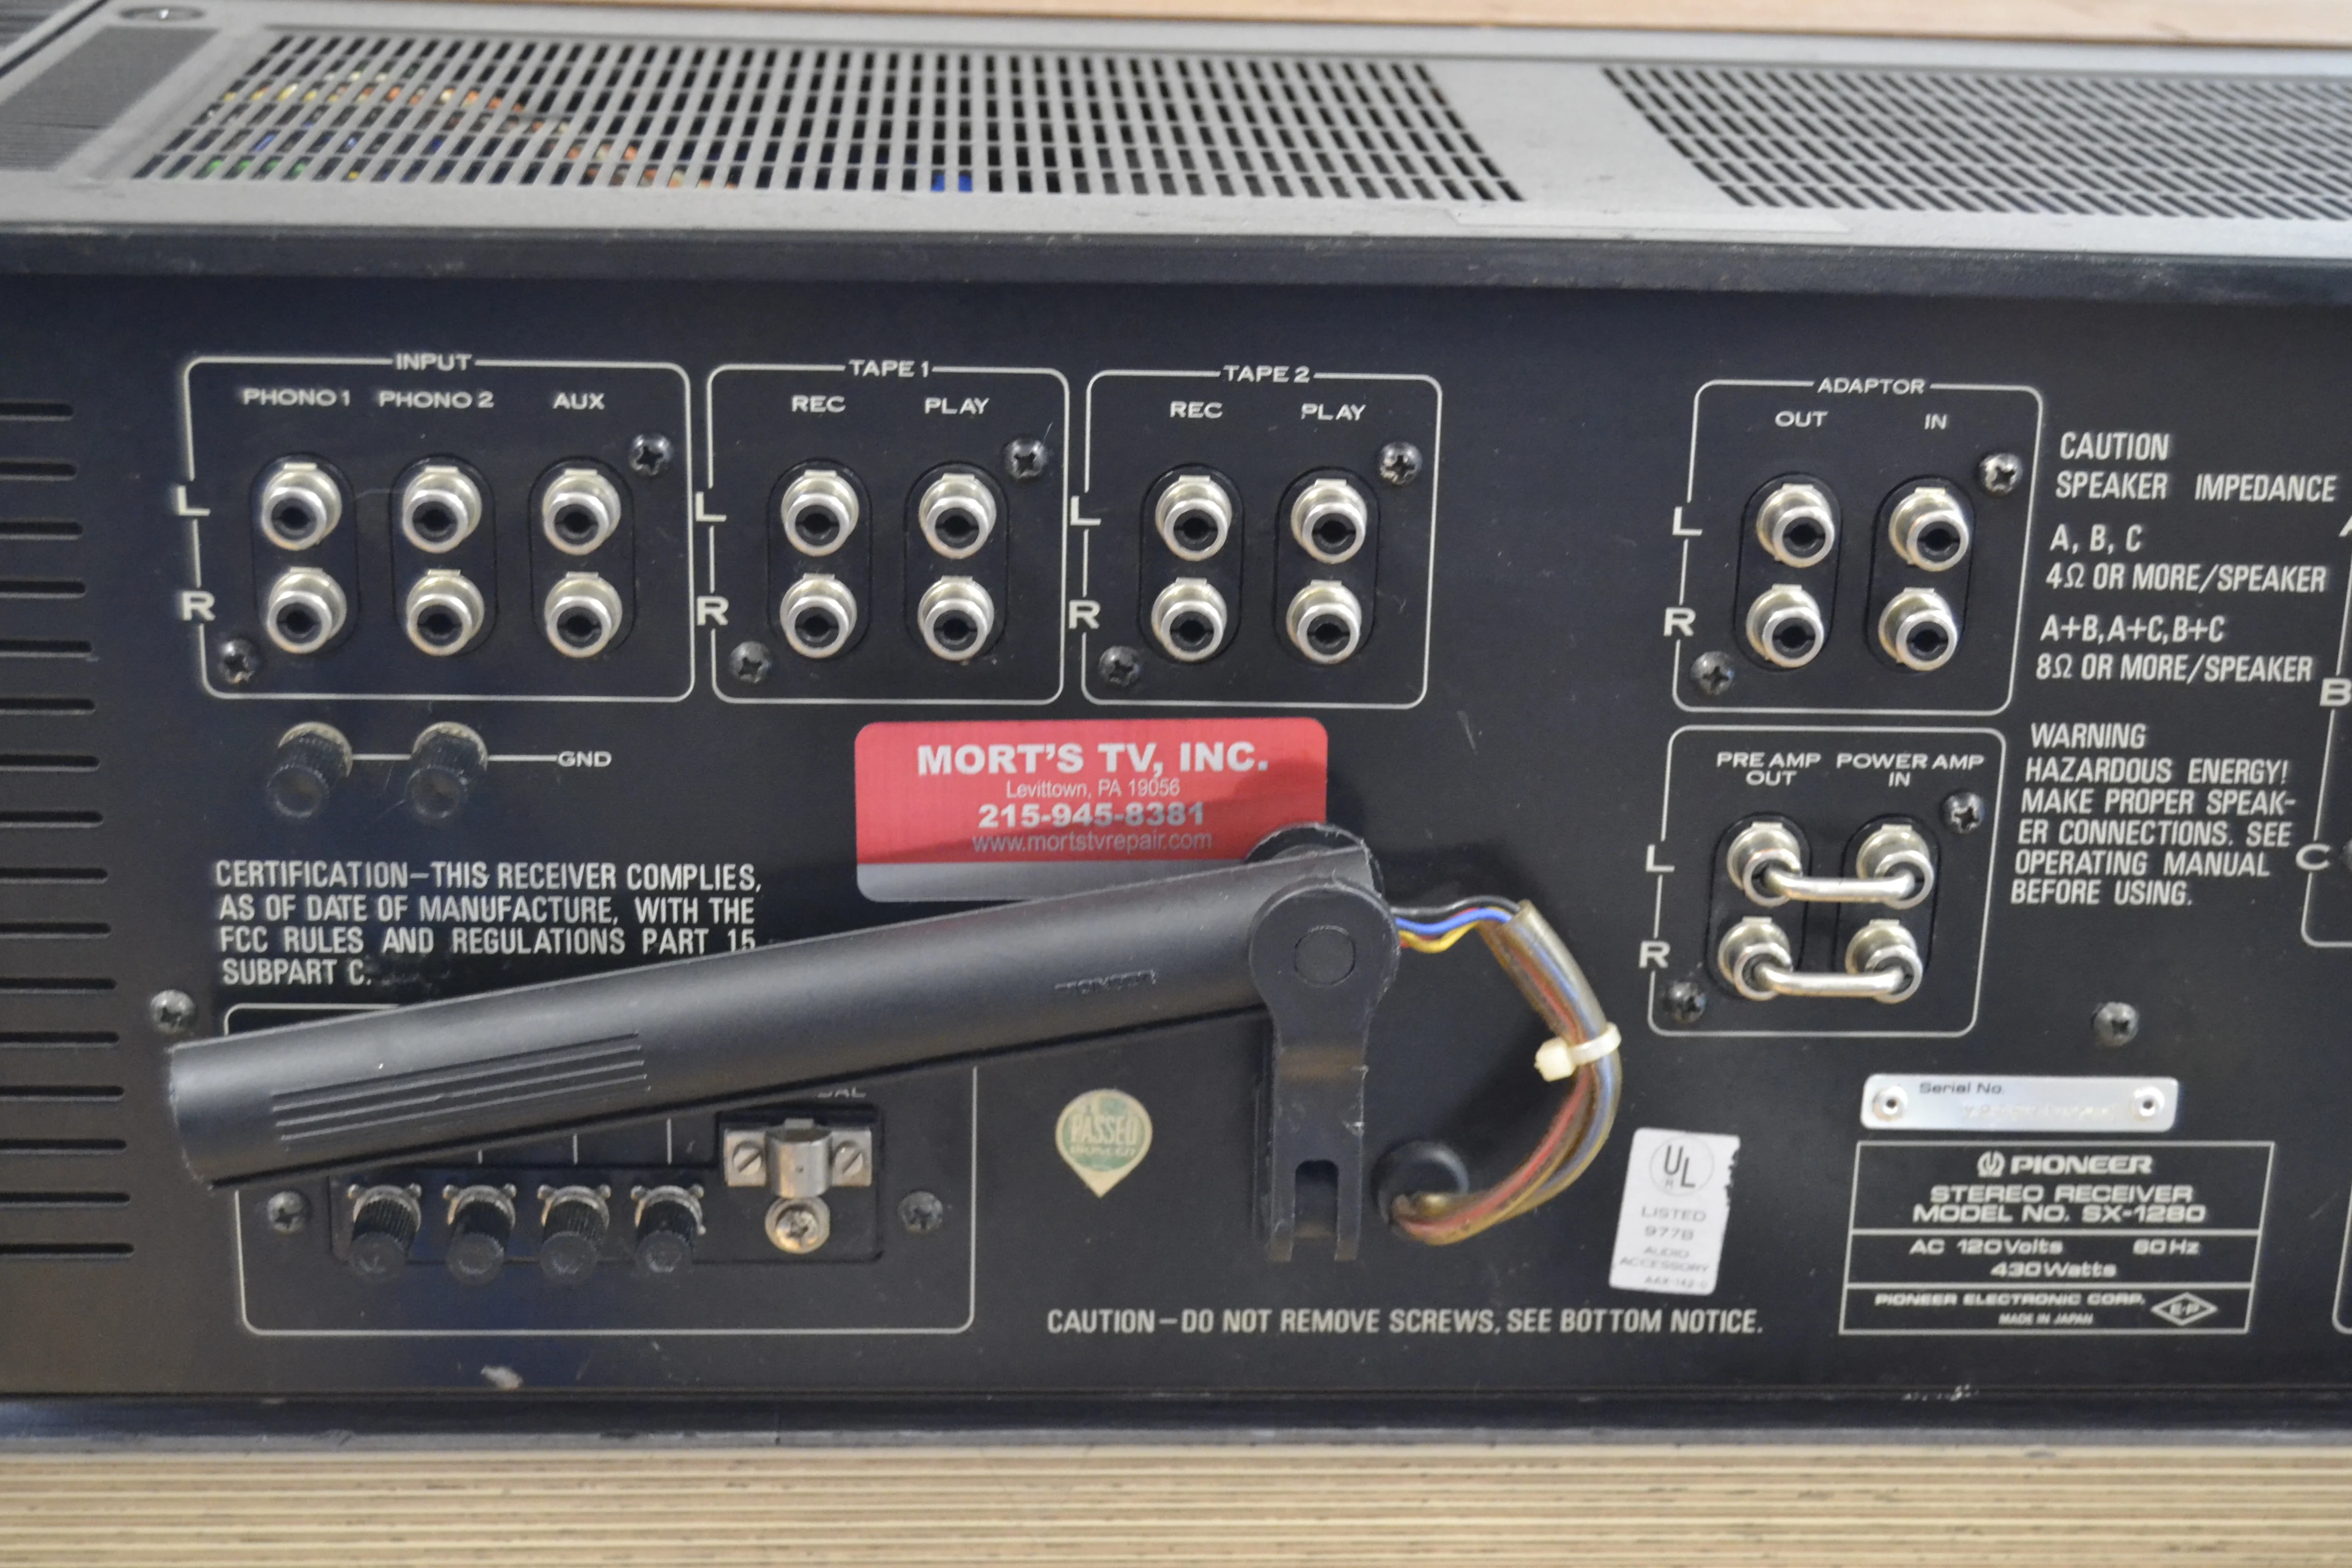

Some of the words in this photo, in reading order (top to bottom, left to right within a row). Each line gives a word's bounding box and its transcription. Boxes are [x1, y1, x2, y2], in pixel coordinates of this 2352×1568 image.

[395, 352, 473, 372] INPUT
[848, 359, 915, 378] TAPE
[921, 360, 929, 378] 1
[1222, 364, 1290, 383] TAPE
[1293, 365, 1311, 383] 2
[241, 387, 338, 407] PHONO
[340, 389, 351, 407] 1
[1817, 377, 1926, 395] ADAPTOR
[377, 389, 473, 409] PHONO
[477, 390, 495, 409] 2
[552, 392, 605, 410] AUX
[791, 395, 846, 413] REC
[924, 397, 990, 415] PLAY
[1169, 400, 1223, 419] REC
[1301, 403, 1366, 422] PLAY
[1774, 410, 1829, 428] OUT
[1924, 413, 1948, 430] IN
[2060, 431, 2170, 461] CAUTION
[2055, 470, 2169, 500] SPEAKER
[2194, 473, 2338, 503] IMPEDANCE
[175, 485, 211, 517] L
[695, 492, 727, 522] L
[1069, 495, 1102, 526] L
[1672, 506, 1703, 536] L
[2125, 524, 2143, 553] C
[2092, 562, 2126, 591] OR
[180, 590, 216, 621] R
[697, 596, 729, 626] R
[1068, 599, 1101, 629] R
[1663, 606, 1697, 637] R
[2080, 652, 2115, 680] OR
[2319, 677, 2352, 707] B
[2030, 722, 2147, 749] WARNING
[557, 750, 613, 768] GND
[1097, 742, 1164, 778] TV,
[1179, 741, 1268, 772] INC.
[1716, 751, 1766, 768] PRE
[1771, 752, 1822, 769] AMP
[1835, 752, 1929, 770] POWER
[1931, 753, 1985, 770] AMP
[2025, 756, 2173, 785] HAZARDOUS
[2187, 757, 2289, 785] ENERGY!
[1006, 779, 1092, 800] Levittown,
[1097, 777, 1122, 797] PA
[1128, 778, 1181, 798] 19056
[1745, 769, 1797, 787] OUT
[1888, 771, 1911, 788] IN
[2021, 787, 2095, 815] MAKE
[2104, 788, 2196, 815] PROPER
[2206, 788, 2296, 816] SPEAK-
[977, 800, 1203, 829] 215-945-8381
[972, 830, 1213, 854] www.mortstvrepair.com
[2017, 818, 2049, 845] ER
[2245, 820, 2293, 848] SEE
[1645, 844, 1676, 873] L
[2014, 848, 2148, 877] OPERATING
[2163, 850, 2270, 877] MANUAL
[2295, 843, 2331, 871] C
[497, 862, 617, 890] RECEIVER
[626, 862, 762, 893] COMPLIES,
[2010, 877, 2102, 905] BEFORE
[2114, 878, 2193, 906] USING.
[218, 893, 256, 921] AS
[264, 893, 297, 922] OF
[306, 894, 368, 922] DATE
[376, 894, 408, 922] OF
[419, 895, 619, 926] MANUFACTURE,
[633, 896, 699, 924] WITH
[707, 896, 755, 925] THE
[218, 925, 268, 953] FCC
[282, 925, 364, 954] RULES
[381, 926, 434, 954] AND
[451, 927, 626, 955] REGULATIONS
[642, 927, 710, 955] PART
[1638, 940, 1671, 968] R
[221, 957, 338, 986] SUBPART
[346, 958, 372, 986] C.
[1919, 1082, 1971, 1094] Serial
[2010, 1154, 2153, 1175] PIONEER
[1929, 1184, 2045, 1204] STEREO
[2054, 1184, 2194, 1204] RECEIVER
[1640, 1206, 1708, 1222] LISTED
[1912, 1204, 2014, 1223] MODEL
[2021, 1204, 2070, 1223] NO.
[2081, 1204, 2207, 1223] SX-1280
[1644, 1246, 1690, 1259] AUDIO
[1908, 1238, 1946, 1255] AC
[1619, 1257, 1709, 1272] ACCESSORY
[1874, 1292, 1958, 1307] PIONEER
[1962, 1292, 2082, 1306] ELECTRONIC
[2086, 1292, 2146, 1306] CORP.
[1222, 1308, 1273, 1333] NOT
[1280, 1308, 1381, 1334] REMOVE
[1506, 1308, 1553, 1333] SEE
[1559, 1308, 1663, 1333] BOTTOM
[1670, 1308, 1763, 1334] NOTICE.
[1998, 1312, 2033, 1326] MADE
[2036, 1312, 2051, 1325] IN
[2053, 1312, 2094, 1326] JAPAN
